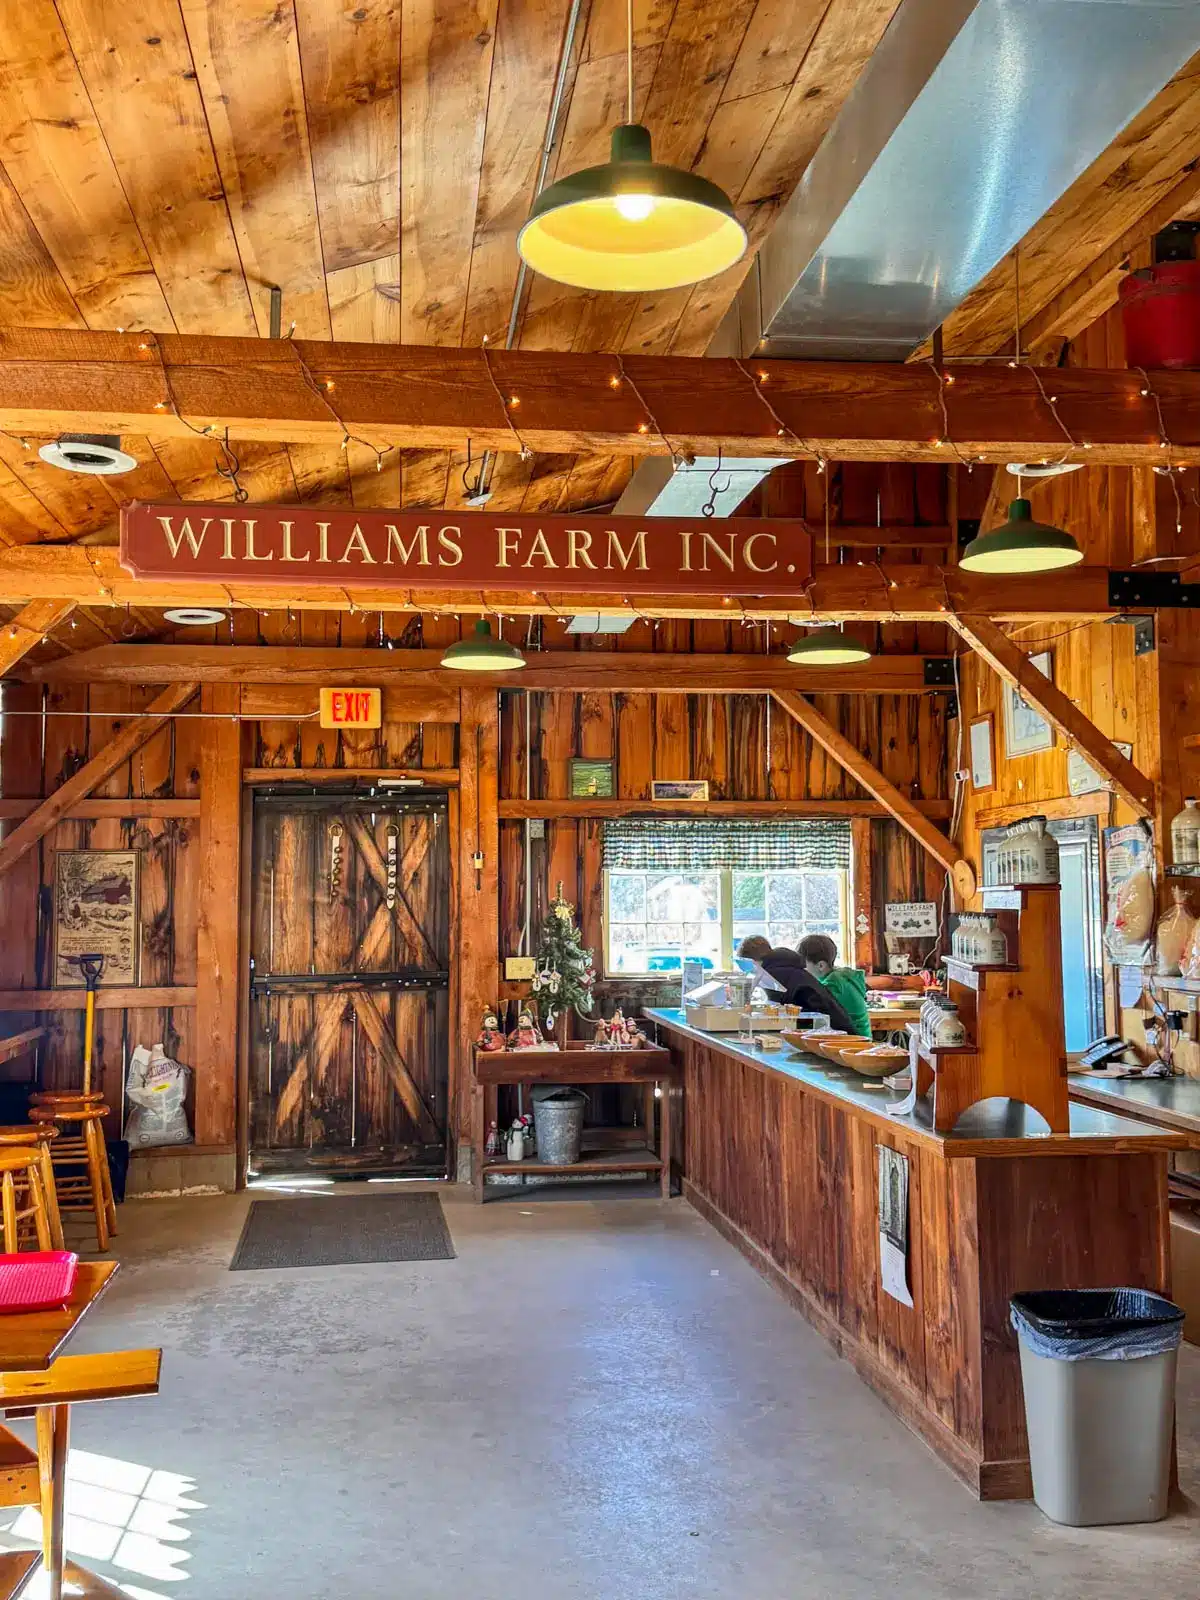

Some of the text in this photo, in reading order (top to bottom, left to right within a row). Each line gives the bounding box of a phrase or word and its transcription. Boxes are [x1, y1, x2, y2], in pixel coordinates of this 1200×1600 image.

[156, 516, 797, 575] WILLIAMS FARM INC.
[332, 692, 371, 722] EXIT
